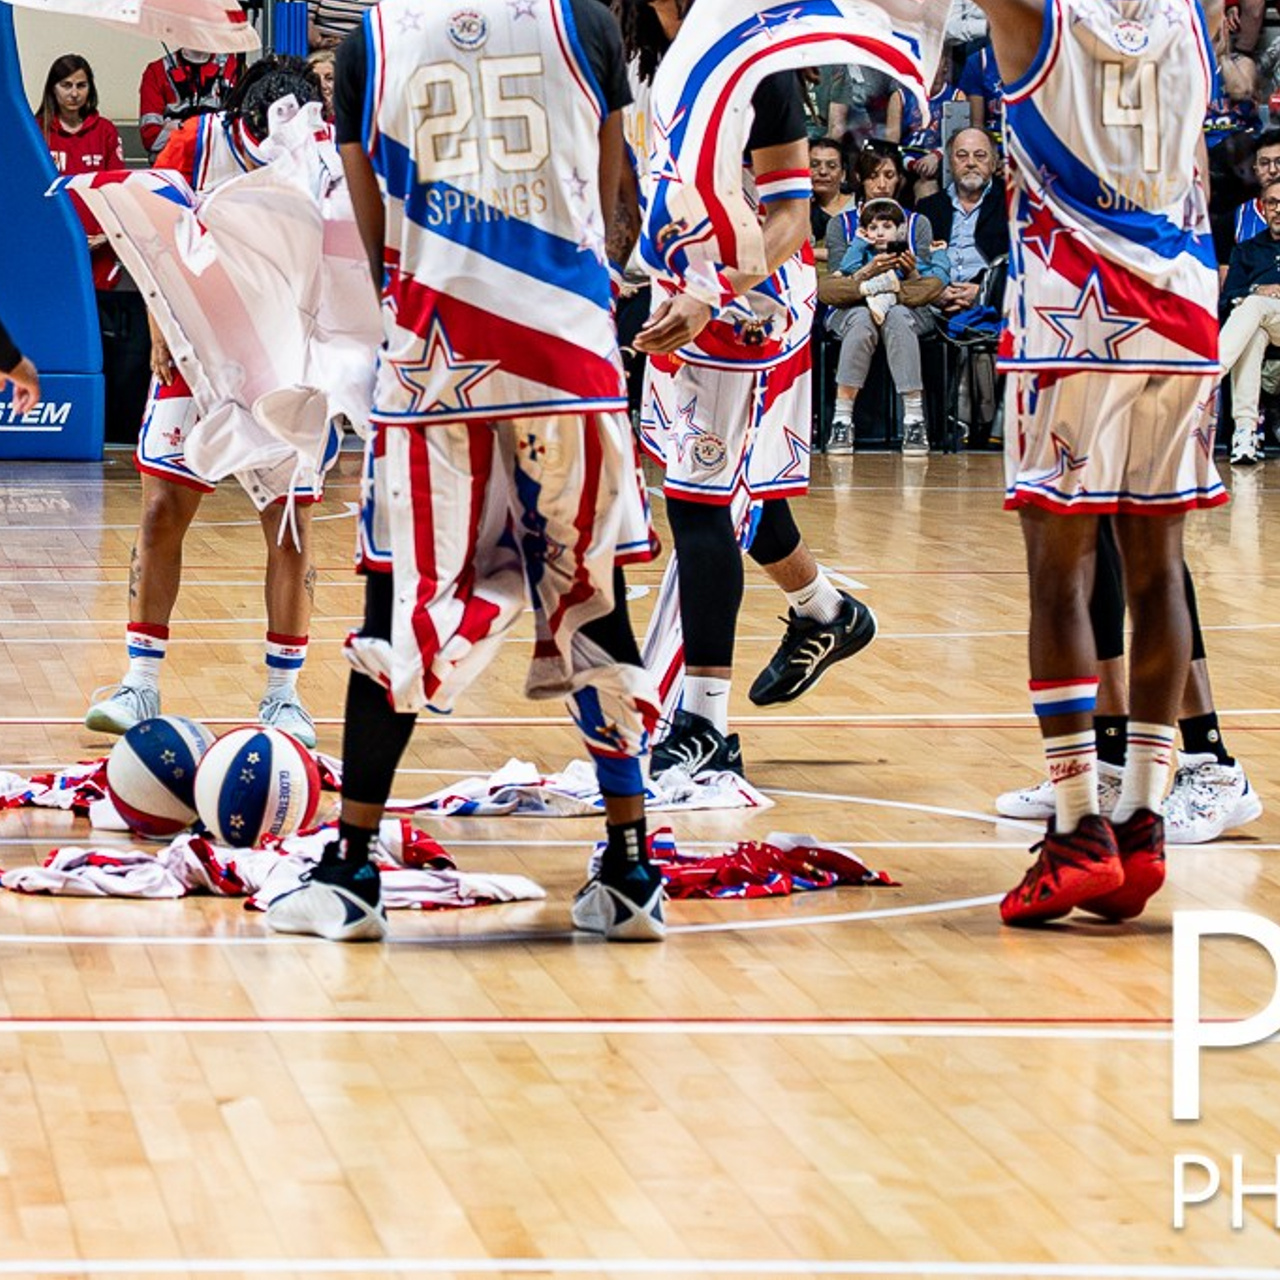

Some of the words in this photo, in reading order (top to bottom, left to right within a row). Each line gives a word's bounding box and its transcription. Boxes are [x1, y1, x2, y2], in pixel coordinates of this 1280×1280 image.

[408, 54, 551, 184] 25
[1102, 61, 1159, 172] 4
[425, 179, 548, 226] SPRINGS
